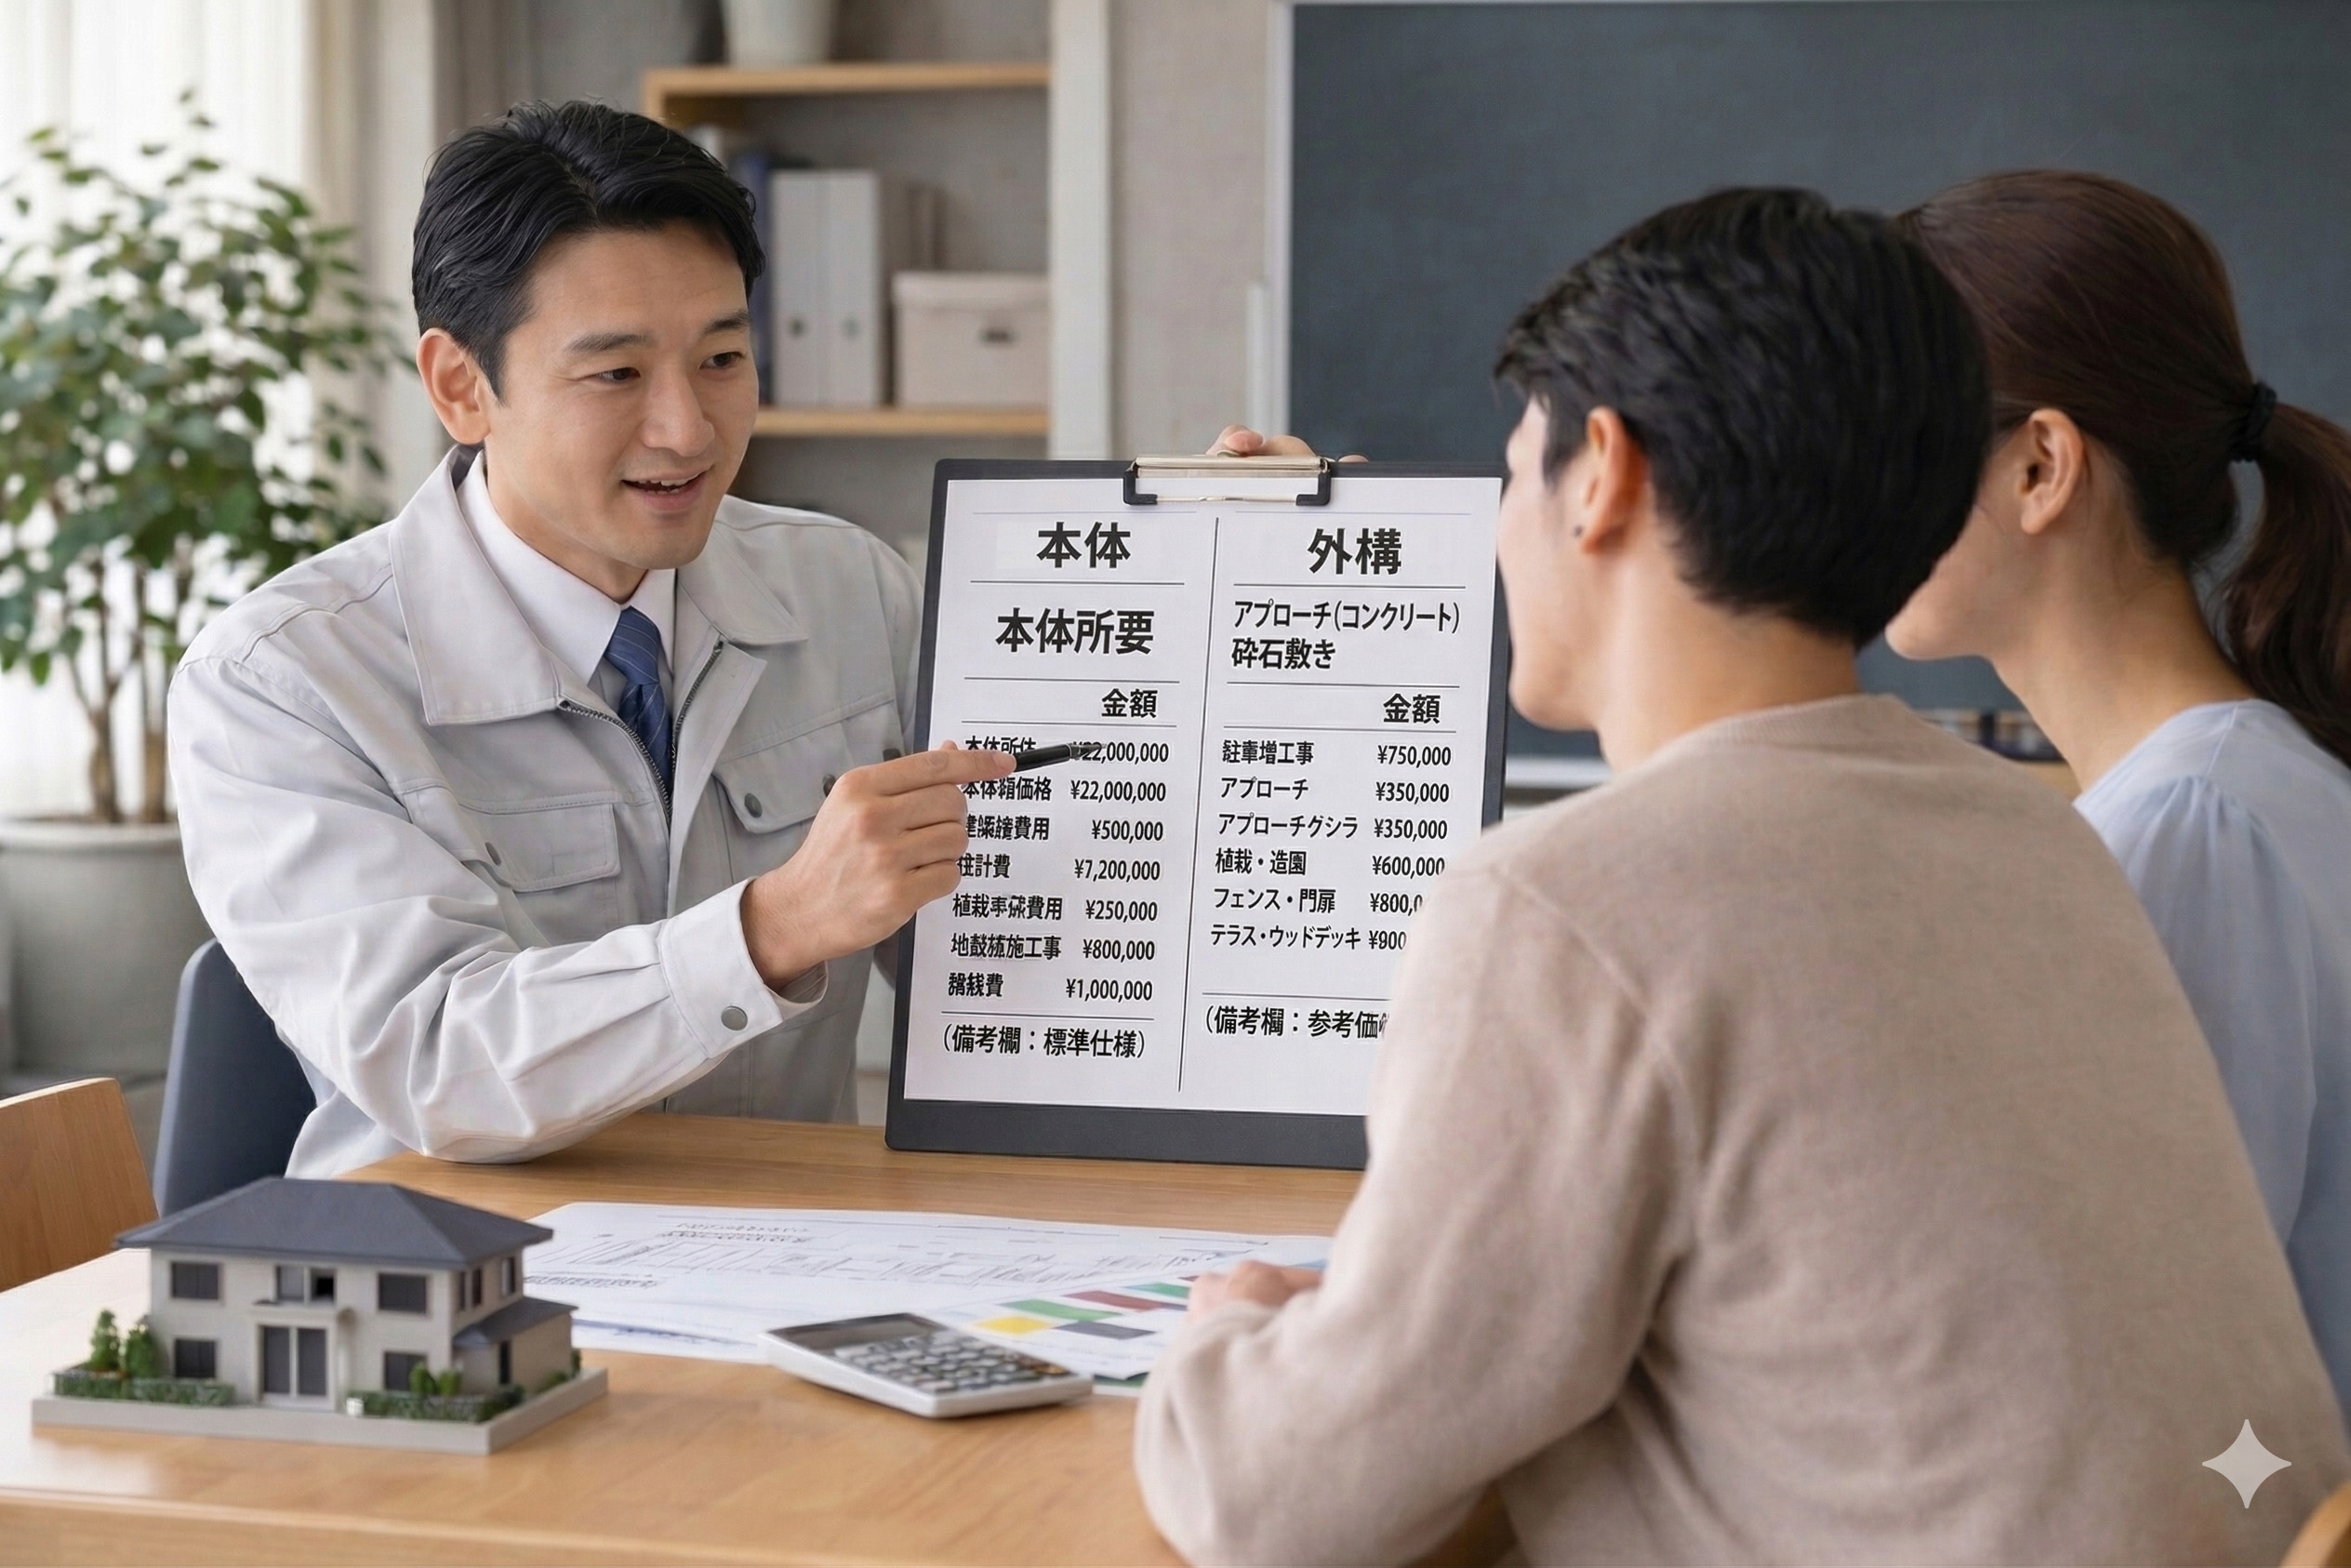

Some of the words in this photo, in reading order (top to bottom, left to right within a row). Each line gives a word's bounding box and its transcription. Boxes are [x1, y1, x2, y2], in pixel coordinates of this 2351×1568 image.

[1036, 521, 1131, 569] 本体
[1307, 527, 1402, 576] 外構
[1234, 598, 1460, 634] アプローチ(コンクリート)
[995, 607, 1155, 655] 本体所要
[1231, 637, 1336, 670] 砕石敷き
[1101, 687, 1159, 719] 金額
[1383, 693, 1441, 724] 金額
[1377, 745, 1452, 769] ¥750,000
[1070, 779, 1166, 804] ¥22,000,000
[1221, 776, 1308, 801] アプローチ
[1375, 781, 1450, 805] ¥350,000
[1091, 819, 1163, 844] ¥500,000
[1374, 817, 1448, 843] ¥350,000
[1074, 858, 1161, 884] ¥7,200,000
[1372, 855, 1445, 880] ¥600,000
[1085, 899, 1158, 924] ¥250,000
[1214, 888, 1336, 914] フェンス・門扉
[1211, 924, 1361, 950] テラス・ウッドデッキ
[1082, 938, 1155, 963] ¥800,000
[1065, 977, 1153, 1003] ¥1,000,000
